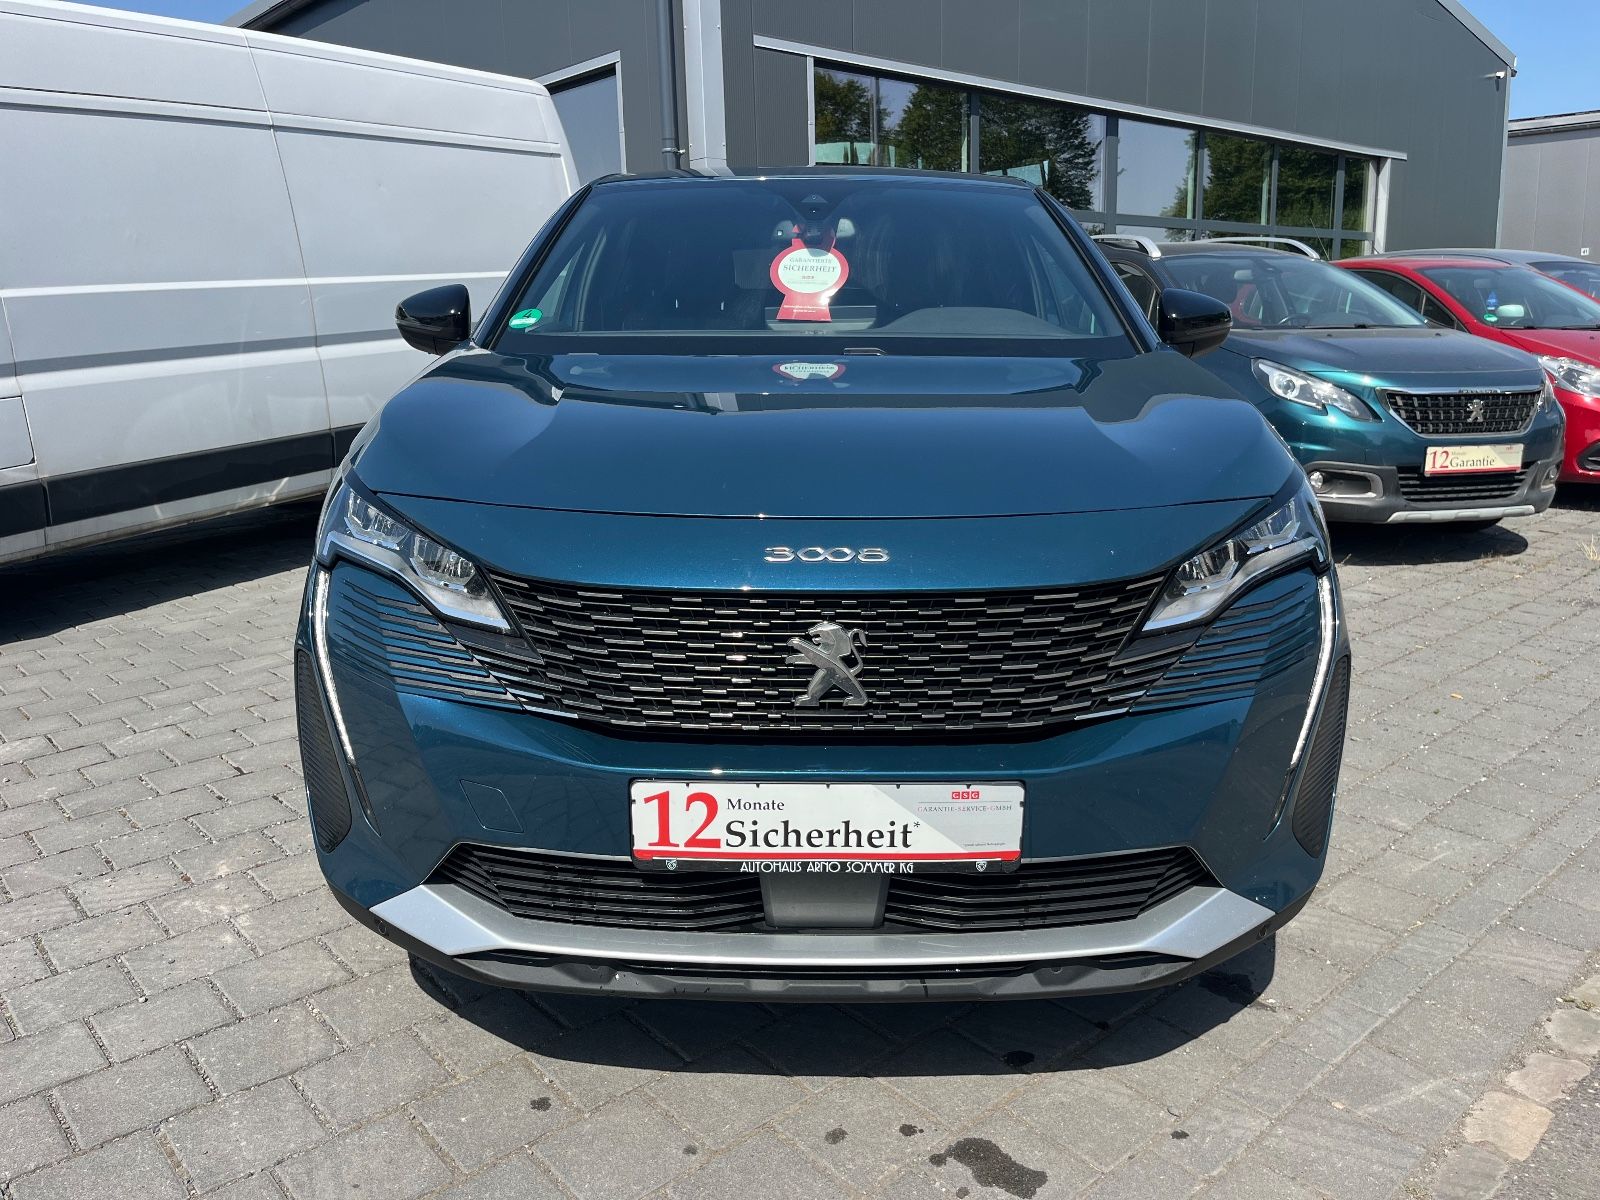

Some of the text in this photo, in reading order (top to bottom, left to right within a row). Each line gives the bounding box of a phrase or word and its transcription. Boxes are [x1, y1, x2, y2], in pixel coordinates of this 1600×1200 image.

[783, 264, 836, 272] SICHERHEIT
[1430, 450, 1449, 468] 12
[764, 547, 889, 563] 3008
[727, 798, 785, 810] Monate
[643, 790, 721, 848] 12
[740, 861, 914, 873] AUTOHAUS ARNO SOMMER KG
